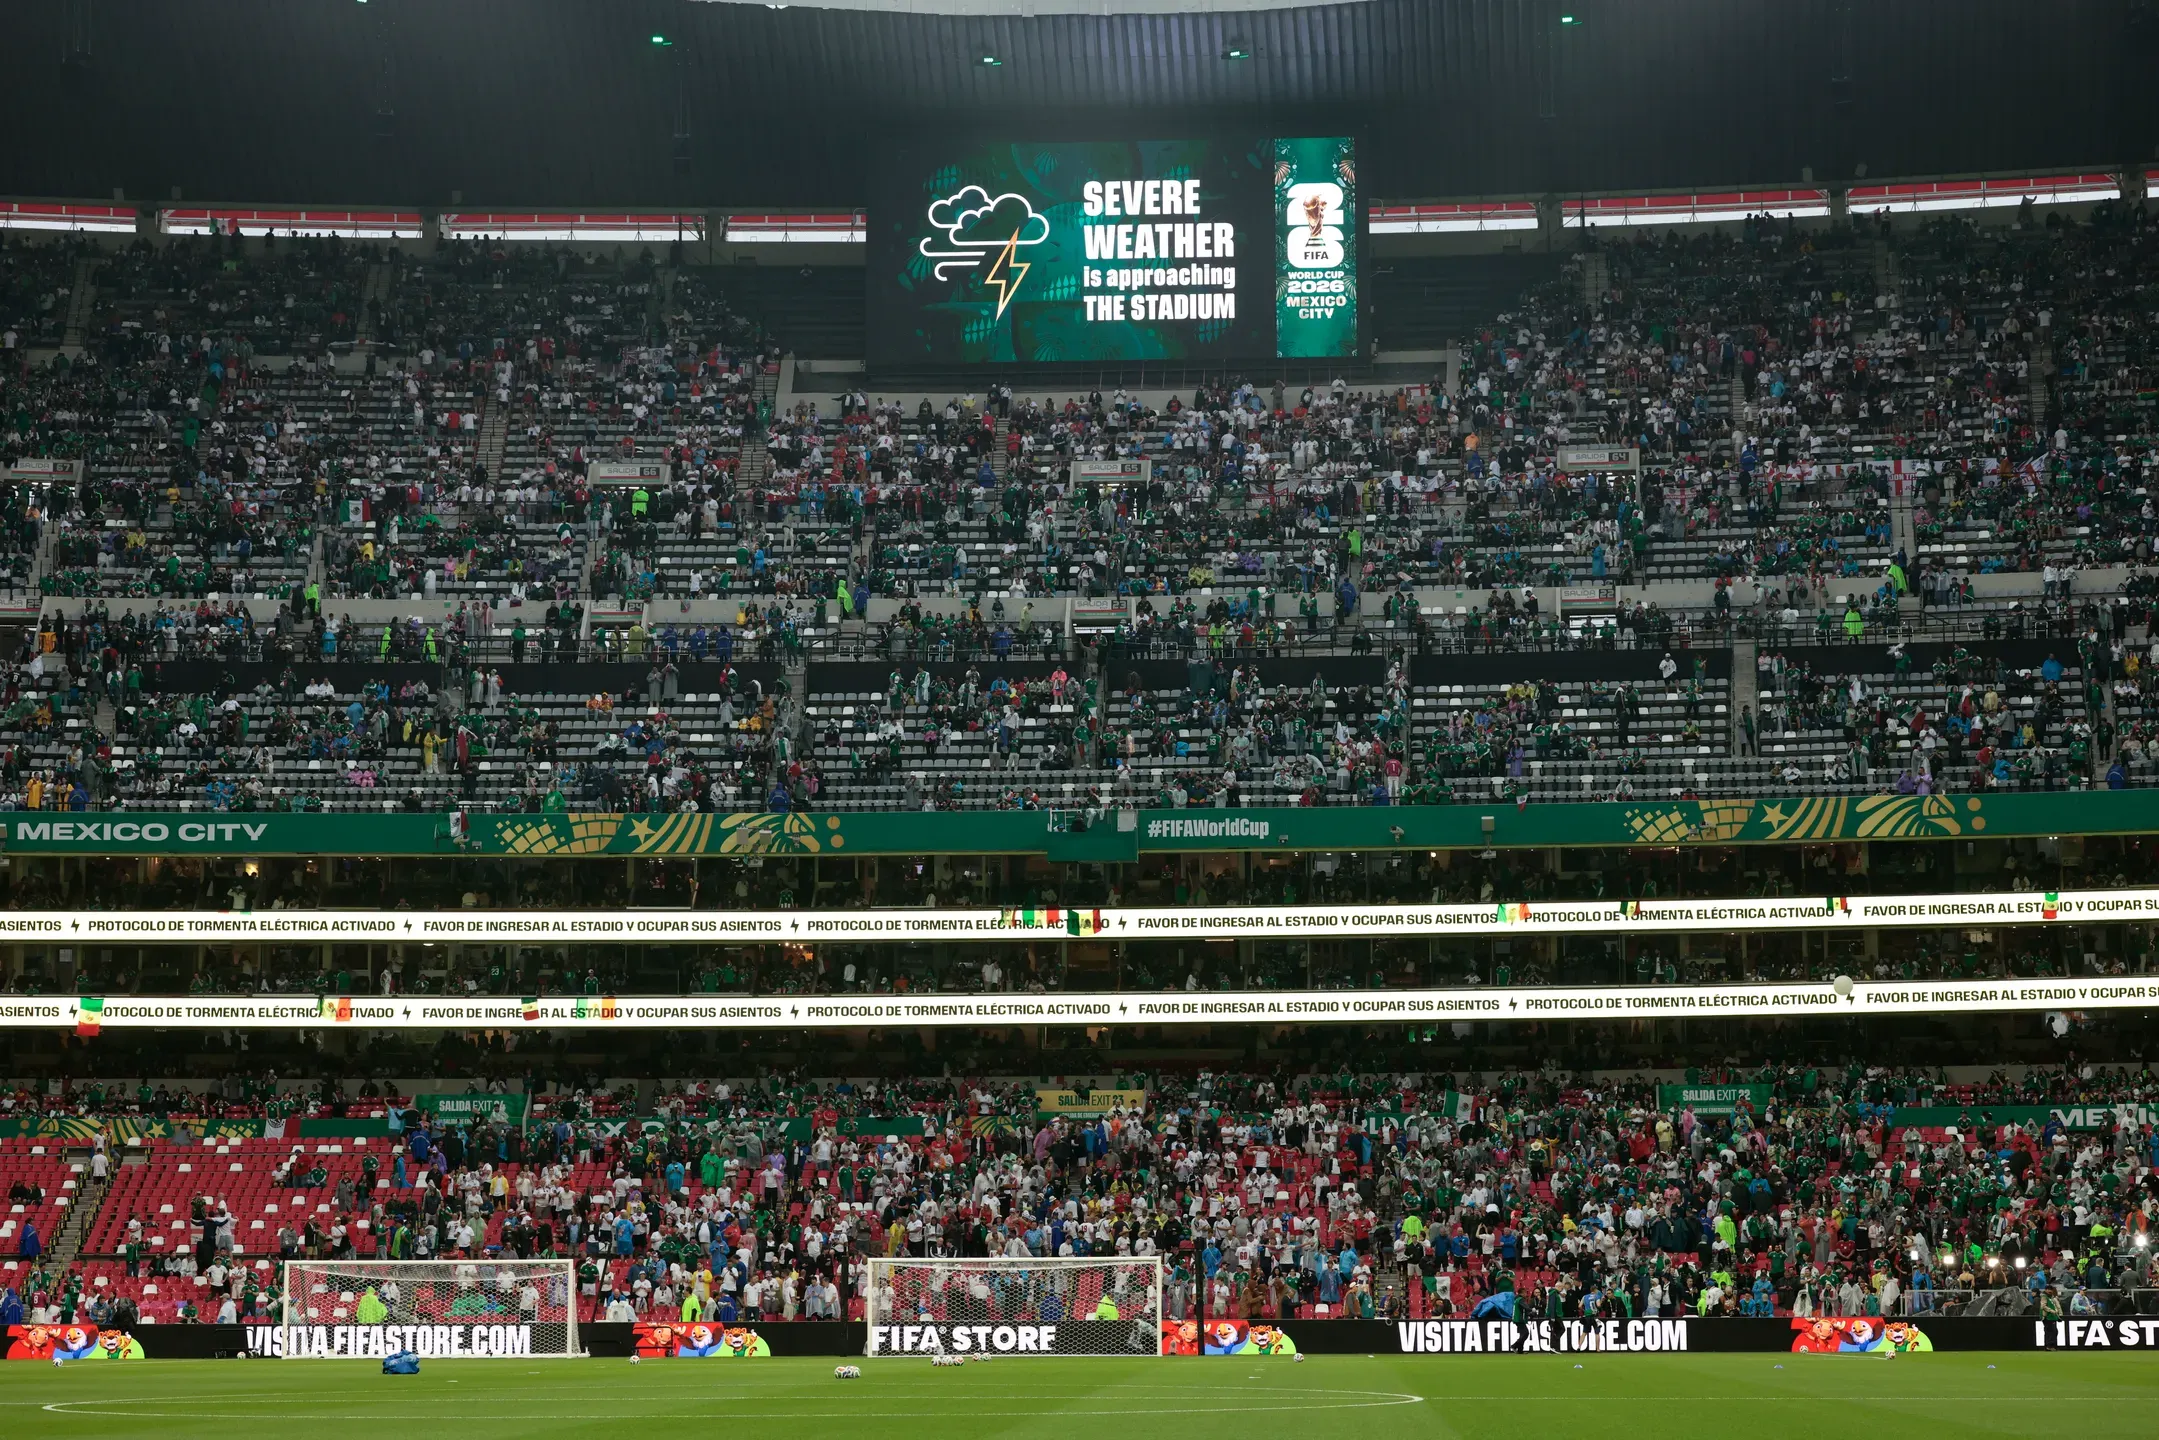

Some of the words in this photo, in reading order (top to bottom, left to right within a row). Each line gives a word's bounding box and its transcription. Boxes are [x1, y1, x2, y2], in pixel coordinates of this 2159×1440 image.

[1083, 179, 1201, 217] SEVERE
[1084, 222, 1235, 261] WEATHER
[1304, 251, 1329, 260] FIFA
[1084, 265, 1102, 288] is
[1106, 264, 1235, 291] approaching
[1288, 272, 1323, 280] WORLD
[1325, 271, 1344, 279] CUP
[1287, 280, 1345, 294] 2026
[1085, 295, 1127, 322] THE
[1131, 293, 1236, 321] STADIUM
[1286, 295, 1347, 307] MEXICO
[1298, 308, 1334, 319] CITY
[1611, 452, 1627, 461] 64
[56, 463, 71, 472] 67
[643, 467, 657, 476] 66
[1124, 464, 1139, 472] 65
[1600, 589, 1615, 598] 22
[27, 599, 41, 608] 25
[628, 603, 643, 612] 24
[1112, 600, 1127, 609] 23
[16, 822, 170, 841] MEXICO
[178, 823, 269, 841] CITY
[1148, 818, 1270, 839] #FIFAWorldCup
[1524, 911, 1601, 924] PROTOCOLO
[1604, 912, 1620, 922] DE
[1697, 906, 1766, 920] ELÉCTRICA
[1769, 907, 1835, 919] ACTIVADO
[1865, 906, 1906, 917] FAVOR
[1910, 904, 1926, 916] DE
[1929, 904, 1994, 915] INGRESAR
[1999, 904, 2014, 914] AL
[2076, 902, 2084, 912] Y
[2088, 900, 2146, 912] OCUPAR
[89, 920, 166, 931] PROTOCOLO
[169, 920, 184, 931] DE
[188, 920, 256, 931] TORMENTA
[261, 918, 328, 931] ELÉCTRICA
[332, 920, 394, 931] ACTIVADO
[424, 922, 464, 932] FAVOR
[468, 922, 484, 932] DE
[487, 922, 550, 932] INGRESAR
[553, 922, 568, 932] AL
[572, 922, 624, 932] ESTADIO
[627, 922, 634, 932] Y
[638, 922, 688, 932] OCUPAR
[692, 920, 716, 932] SUS
[720, 920, 782, 932] ASIENTOS
[808, 920, 882, 931] PROTOCOLO
[886, 920, 902, 931] DE
[904, 920, 974, 931] TORMENTA
[1139, 918, 1178, 929] FAVOR
[1182, 918, 1198, 928] DE
[1201, 916, 1264, 928] INGRESAR
[1267, 916, 1282, 927] AL
[1286, 916, 1338, 927] ESTADIO
[1341, 916, 1348, 926] Y
[1352, 914, 1404, 926] OCUPAR
[1407, 914, 1432, 925] SUS
[1435, 913, 1499, 925] ASIENTOS
[1527, 998, 1602, 1010] PROTOCOLO
[1607, 998, 1622, 1009] DE
[1625, 996, 1696, 1008] TORMENTA
[1699, 994, 1768, 1007] ELÉCTRICA
[1772, 994, 1836, 1006] ACTIVADO
[1867, 992, 1910, 1004] FAVOR
[1913, 992, 1928, 1003] DE
[1932, 990, 1998, 1002] INGRESAR
[2002, 990, 2018, 1001] AL
[2021, 988, 2076, 1000] ESTADIO
[2079, 988, 2088, 999] Y
[2091, 988, 2146, 999] OCUPAR
[101, 1007, 165, 1018] OTOCOLO
[167, 1008, 182, 1018] DE
[186, 1008, 256, 1018] TORMENTA
[423, 1008, 464, 1019] FAVOR
[467, 1008, 482, 1018] DE
[485, 1008, 549, 1019] INGRER
[552, 1008, 568, 1018] AL
[571, 1008, 623, 1019] ESTADIO
[626, 1008, 634, 1018] Y
[637, 1008, 688, 1018] OCUPAR
[692, 1008, 716, 1018] SUS
[720, 1006, 782, 1018] ASIENTOS
[808, 1006, 882, 1017] PROTOCOLO
[887, 1006, 902, 1016] DE
[905, 1006, 974, 1016] TORMENTA
[977, 1002, 1044, 1016] ELÉCTRICA
[1048, 1004, 1110, 1015] ACTIVADO
[1139, 1004, 1180, 1014] FAVOR
[1183, 1004, 1198, 1014] DE
[1202, 1002, 1264, 1014] INGRESAR
[1268, 1002, 1284, 1013] AL
[1287, 1002, 1338, 1013] ESTADIO
[1343, 1002, 1350, 1012] Y
[1354, 1000, 1406, 1012] OCUPAR
[1409, 1000, 1434, 1011] SUS
[1437, 1000, 1500, 1011] ASIENTOS
[1091, 1095, 1110, 1106] EXIT
[1112, 1095, 1124, 1106] 23
[1682, 1089, 1716, 1101] SALIDA
[1716, 1089, 1737, 1101] EXIT
[1738, 1089, 1751, 1101] 22
[439, 1100, 471, 1112] SALIDA
[472, 1100, 493, 1112] EXIT
[246, 1326, 328, 1356] VISITA
[333, 1325, 531, 1355] FIFASTORE.COM
[952, 1326, 1056, 1351] STORE
[1398, 1321, 1483, 1352] VISITA
